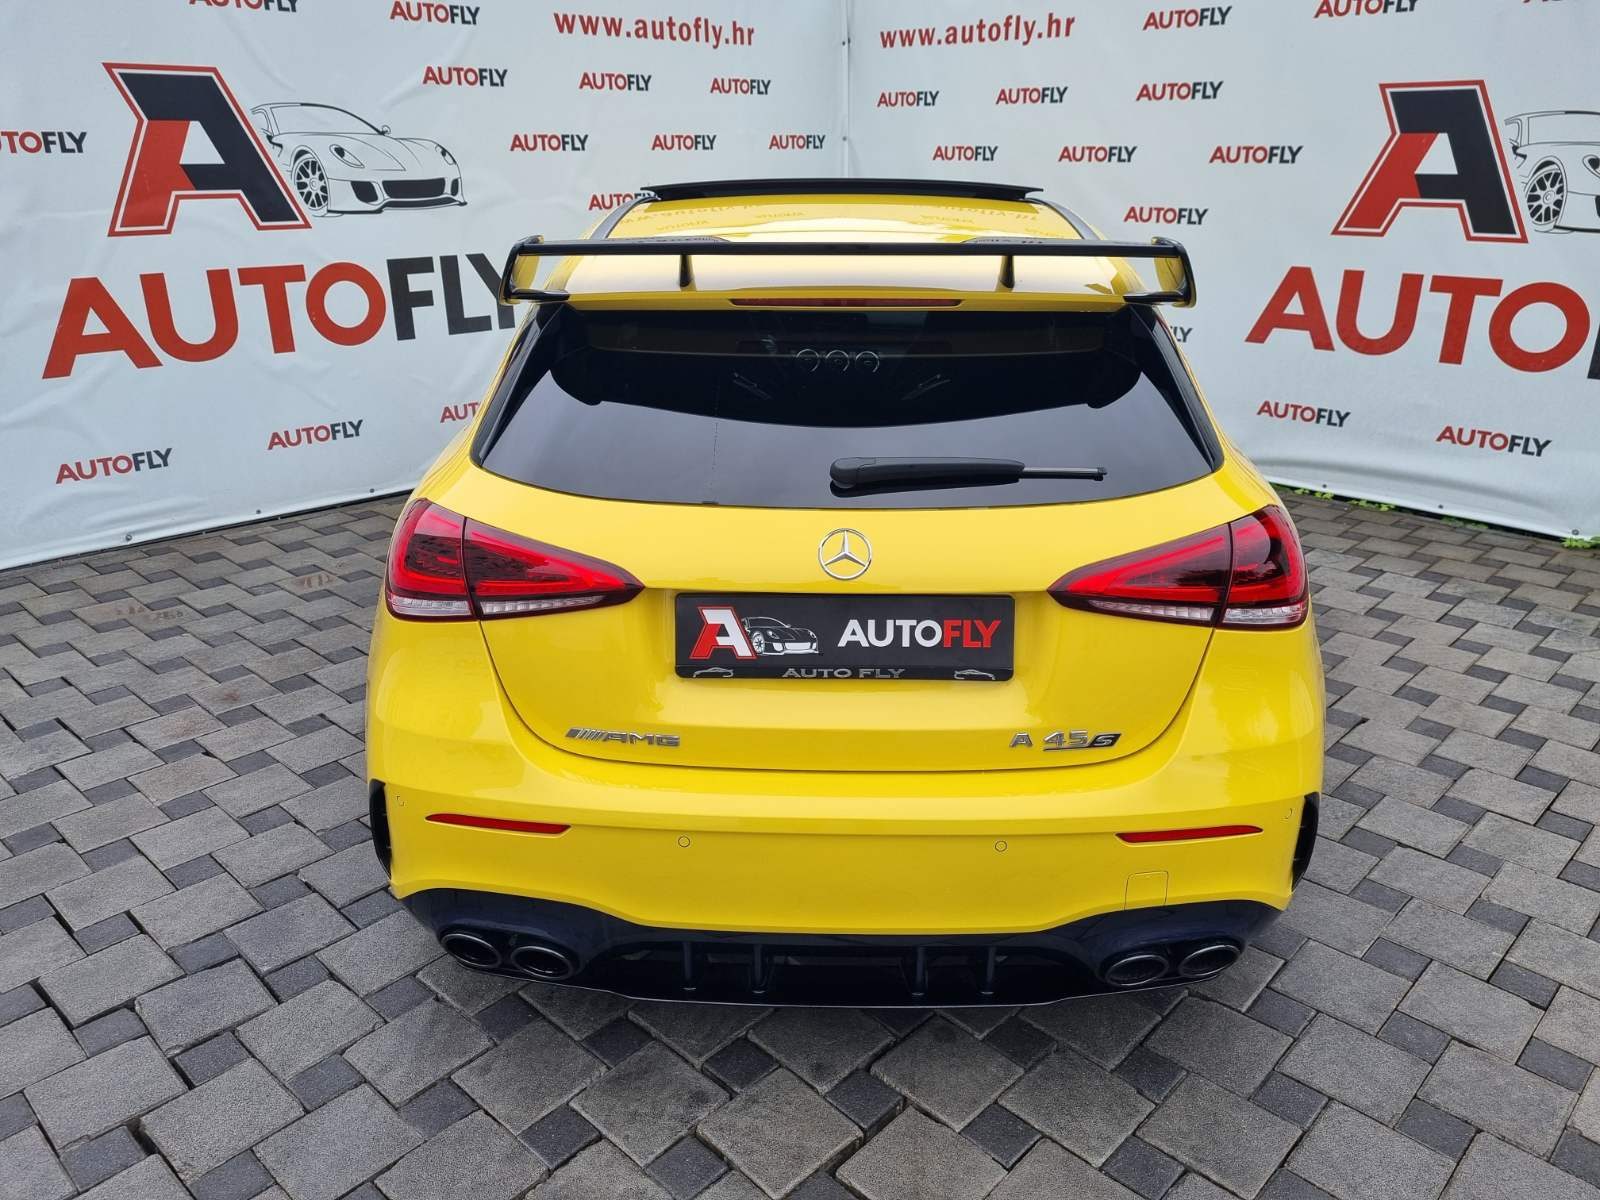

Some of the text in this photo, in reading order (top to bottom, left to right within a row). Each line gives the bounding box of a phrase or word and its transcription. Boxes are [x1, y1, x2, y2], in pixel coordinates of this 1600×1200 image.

[189, 0, 297, 12] OFLY
[390, 1, 480, 25] AUTOFLY
[1143, 6, 1232, 30] AUTOFLY
[554, 13, 754, 49] www.autofly.hr
[880, 13, 1075, 48] www.autofly.hr
[423, 66, 508, 87] AUTOFLY
[579, 72, 652, 91] AUTOFLY
[710, 78, 771, 95] AUTOFLY
[996, 86, 1068, 104] AUTOFLY
[1136, 81, 1224, 101] AUTOFLY
[877, 91, 939, 107] AUTOFLY
[0, 131, 87, 153] TOFLY
[510, 134, 588, 151] AUTOFLY
[652, 135, 717, 150] AUTOFLY
[769, 135, 826, 149] AUTOFLY
[933, 146, 998, 161] AUTOFLY
[1058, 146, 1137, 163] AUTOFLY
[1209, 146, 1303, 164] AUTOFLY
[1124, 206, 1208, 225] AUTOFLY
[1245, 266, 1600, 380] AUTO
[440, 402, 481, 423] AUT
[1257, 401, 1351, 427] AUTOFLY
[268, 419, 363, 450] AUTOFLY
[1436, 426, 1552, 457] AUTOFLY
[56, 448, 172, 484] AUTOFLY
[837, 619, 1001, 648] AUTOFLY
[782, 667, 906, 679] AUTO FLY
[1009, 733, 1033, 748] A
